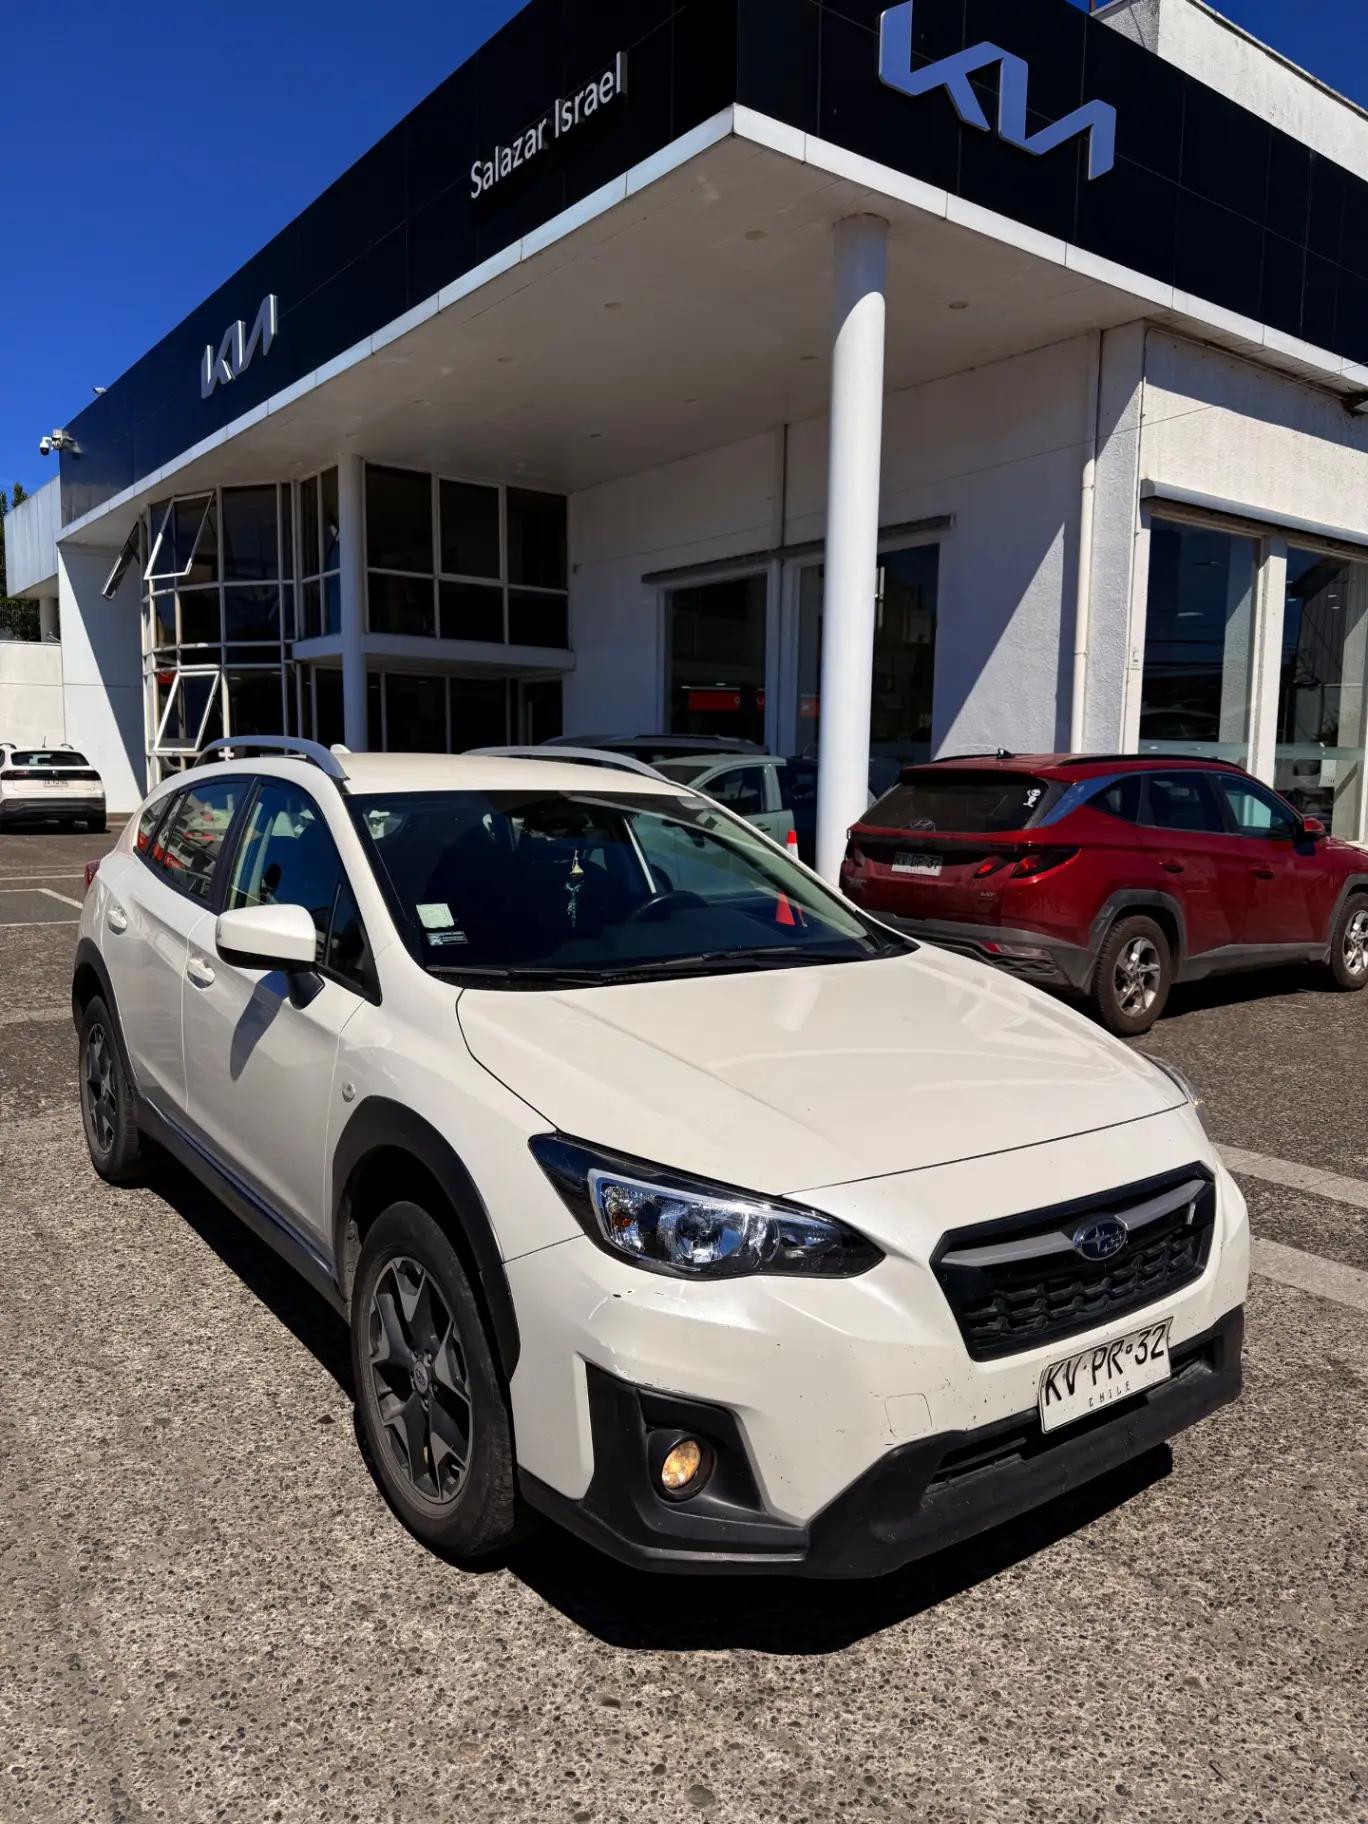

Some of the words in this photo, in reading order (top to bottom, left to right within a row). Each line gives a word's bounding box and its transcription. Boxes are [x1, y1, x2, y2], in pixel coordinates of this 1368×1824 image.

[471, 118, 547, 199] Salazar
[555, 51, 623, 138] Israel
[879, 0, 1117, 180] KIA
[201, 294, 277, 399] KIA
[1089, 1381, 1131, 1407] CHILE
